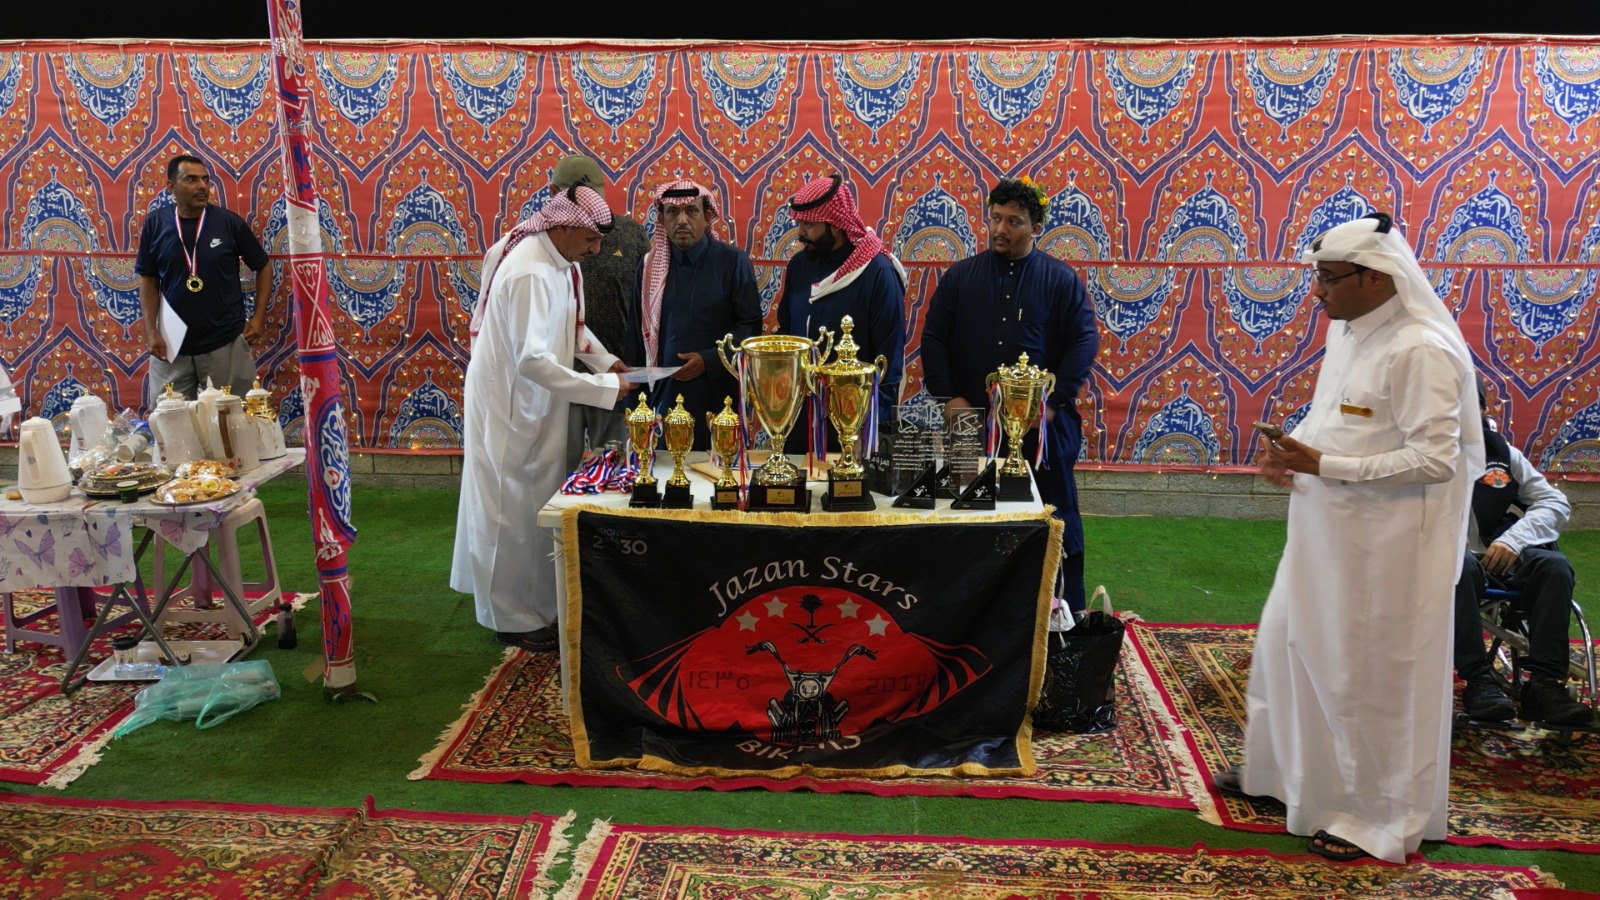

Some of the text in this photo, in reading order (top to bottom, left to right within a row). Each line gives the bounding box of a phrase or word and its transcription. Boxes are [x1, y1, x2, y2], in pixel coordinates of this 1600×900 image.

[592, 534, 648, 555] 230
[709, 556, 918, 617] Jazan Stars
